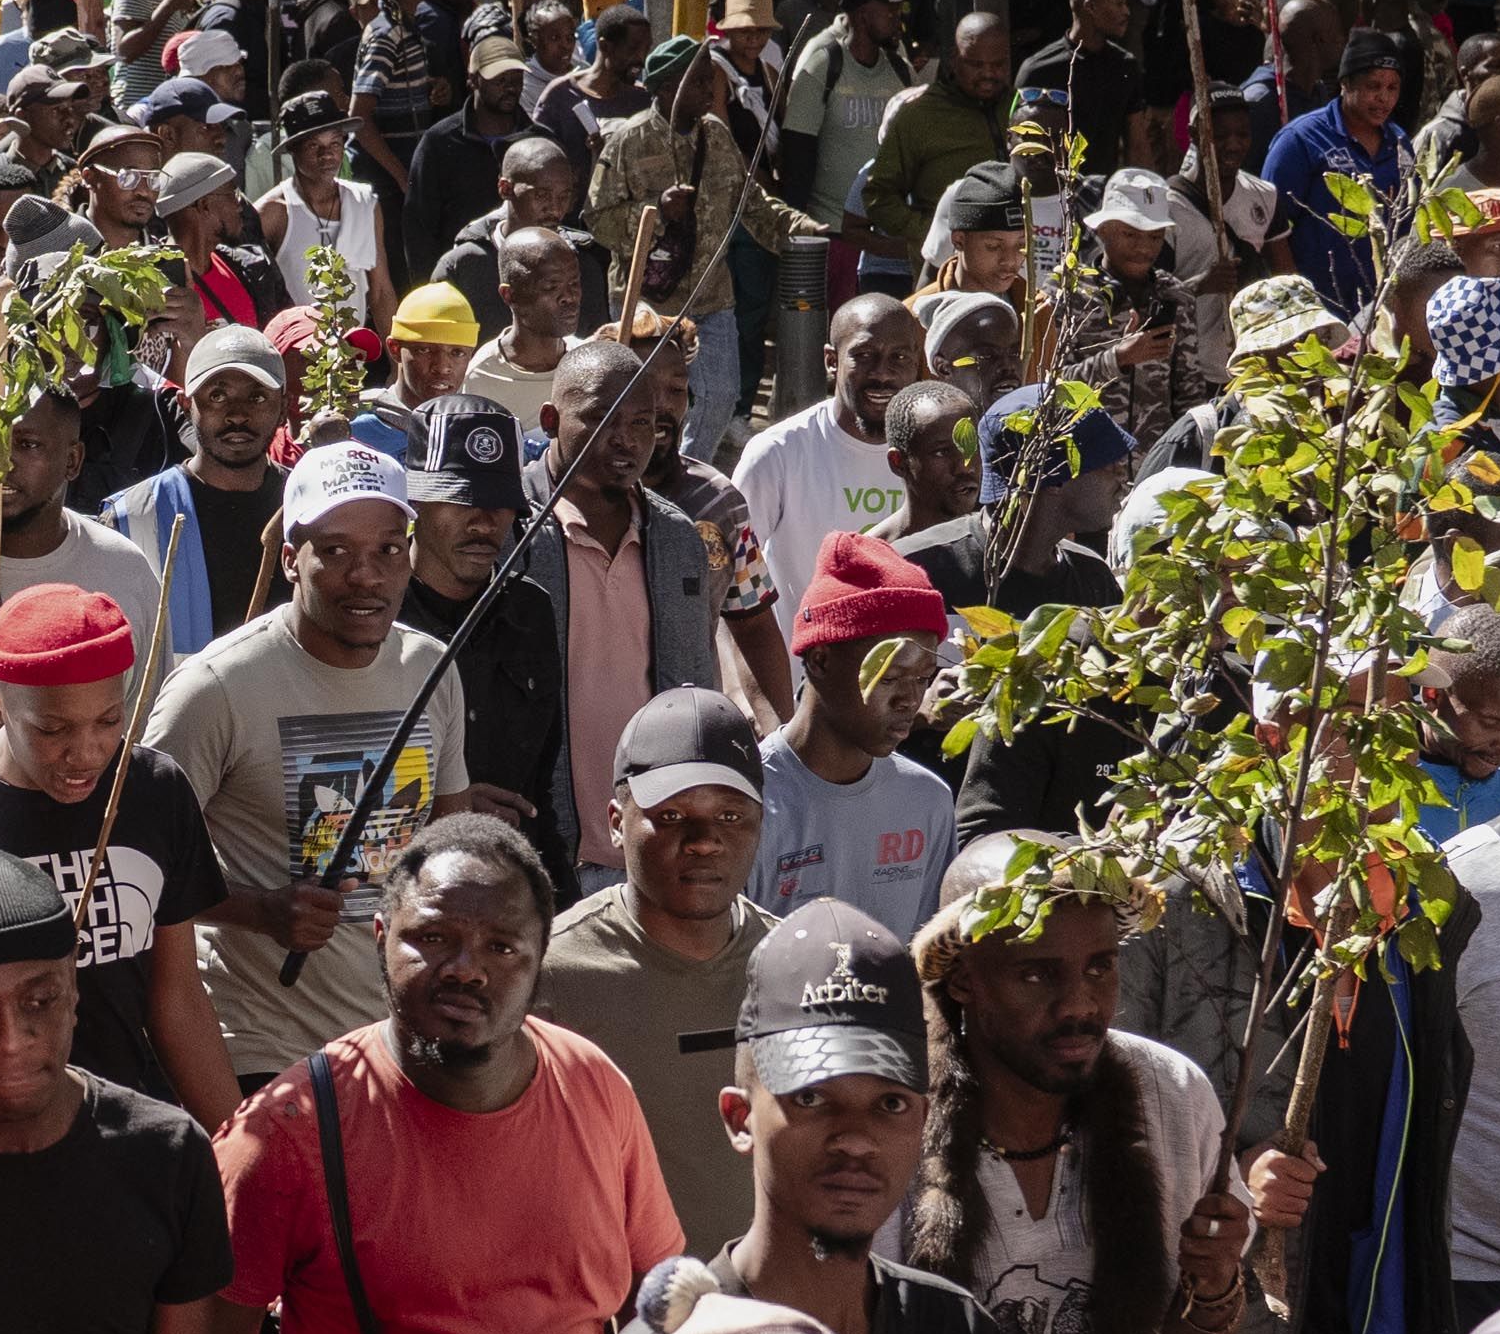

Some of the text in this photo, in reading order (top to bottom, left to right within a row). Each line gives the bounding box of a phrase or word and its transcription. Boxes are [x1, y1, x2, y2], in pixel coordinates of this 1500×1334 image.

[335, 460, 372, 474] AND
[843, 487, 903, 514] VOT
[875, 831, 924, 865] RD
[799, 976, 888, 1008] Arbiter
